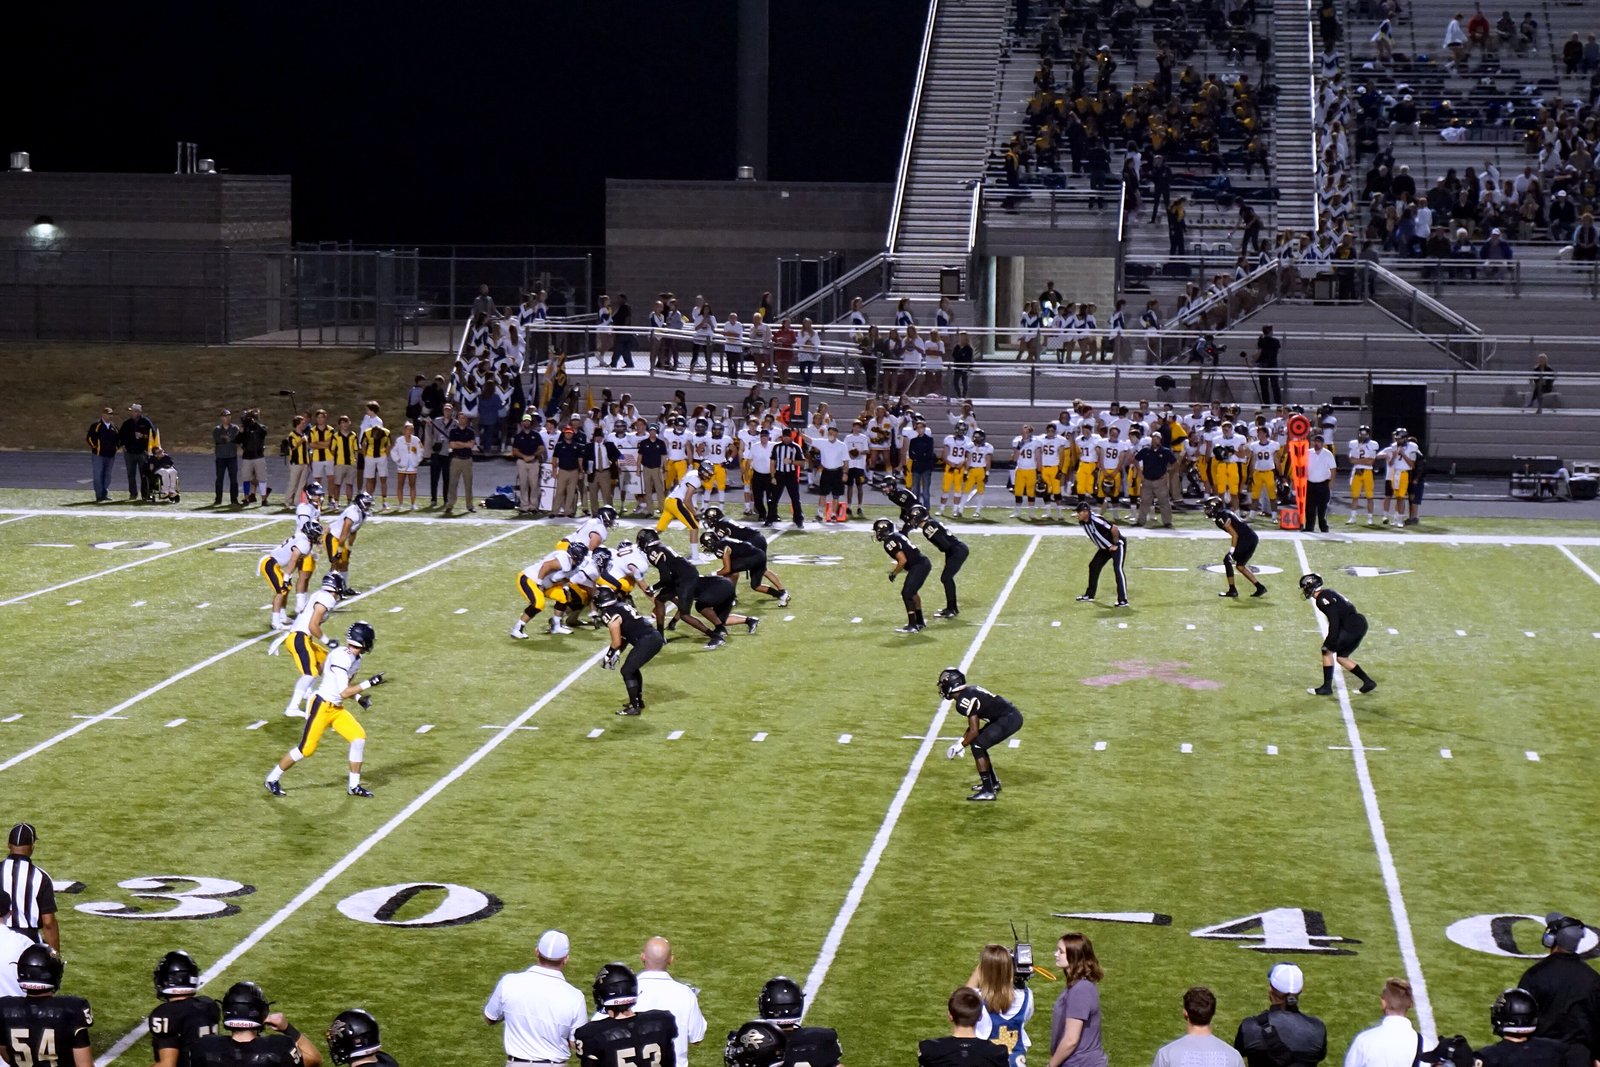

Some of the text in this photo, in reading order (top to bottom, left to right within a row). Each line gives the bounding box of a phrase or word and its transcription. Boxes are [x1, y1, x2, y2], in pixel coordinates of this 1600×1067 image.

[793, 397, 802, 416] 1
[672, 441, 682, 450] 21
[711, 444, 722, 455] 16
[952, 446, 965, 458] 83
[971, 452, 984, 463] 87
[1020, 448, 1033, 459] 49
[1106, 447, 1118, 459] 58
[1282, 511, 1300, 527] 40
[602, 613, 612, 624] 21
[959, 696, 971, 709] 10
[152, 1017, 169, 1034] 51
[229, 1021, 254, 1029] Riddell
[10, 1028, 59, 1067] 54
